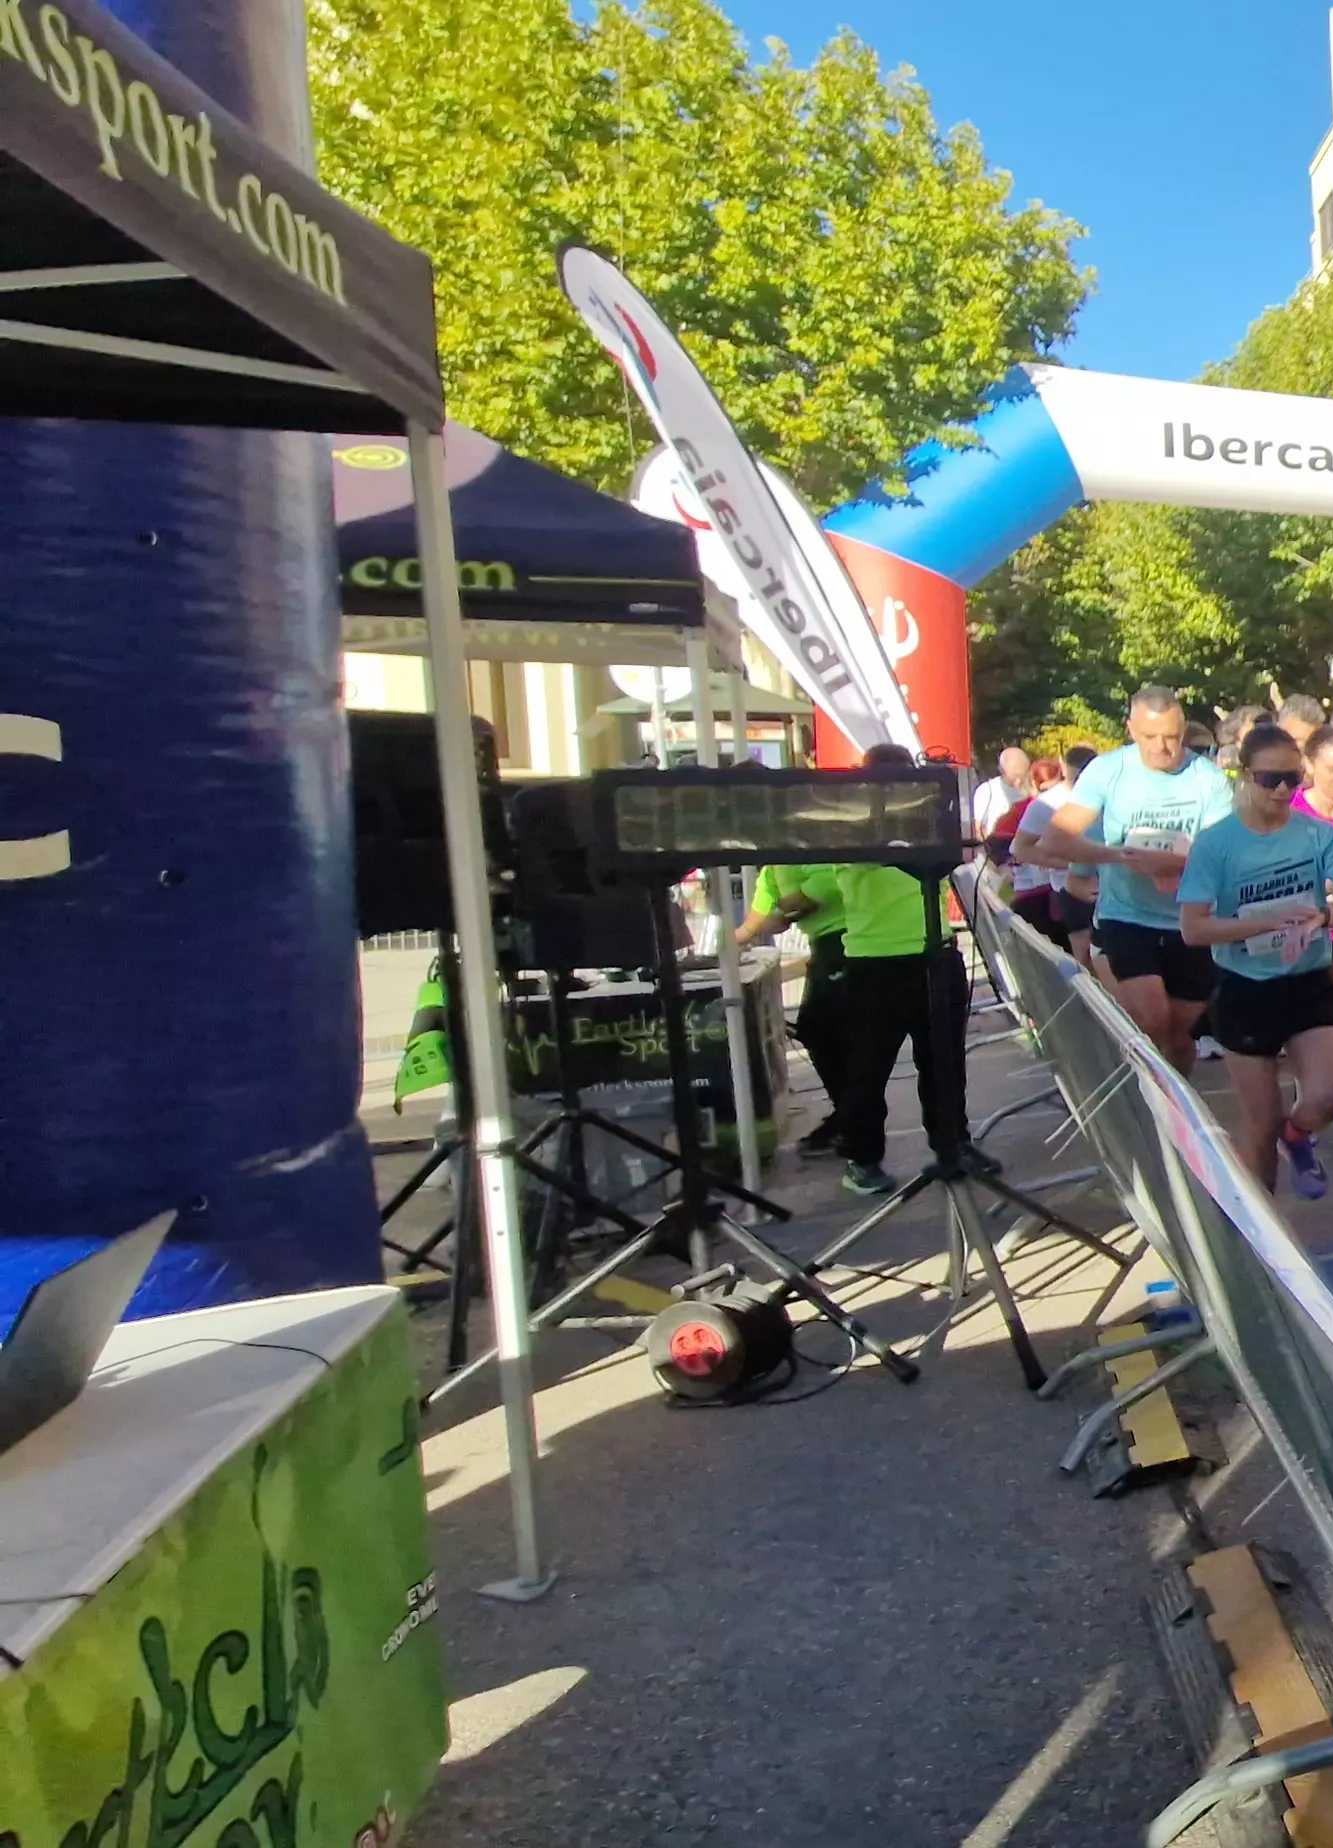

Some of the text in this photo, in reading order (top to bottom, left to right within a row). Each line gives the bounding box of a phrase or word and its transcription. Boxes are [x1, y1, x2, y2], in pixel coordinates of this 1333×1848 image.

[0, 0, 346, 304] ksport.com
[351, 556, 516, 592] com
[620, 1033, 701, 1063] Spot
